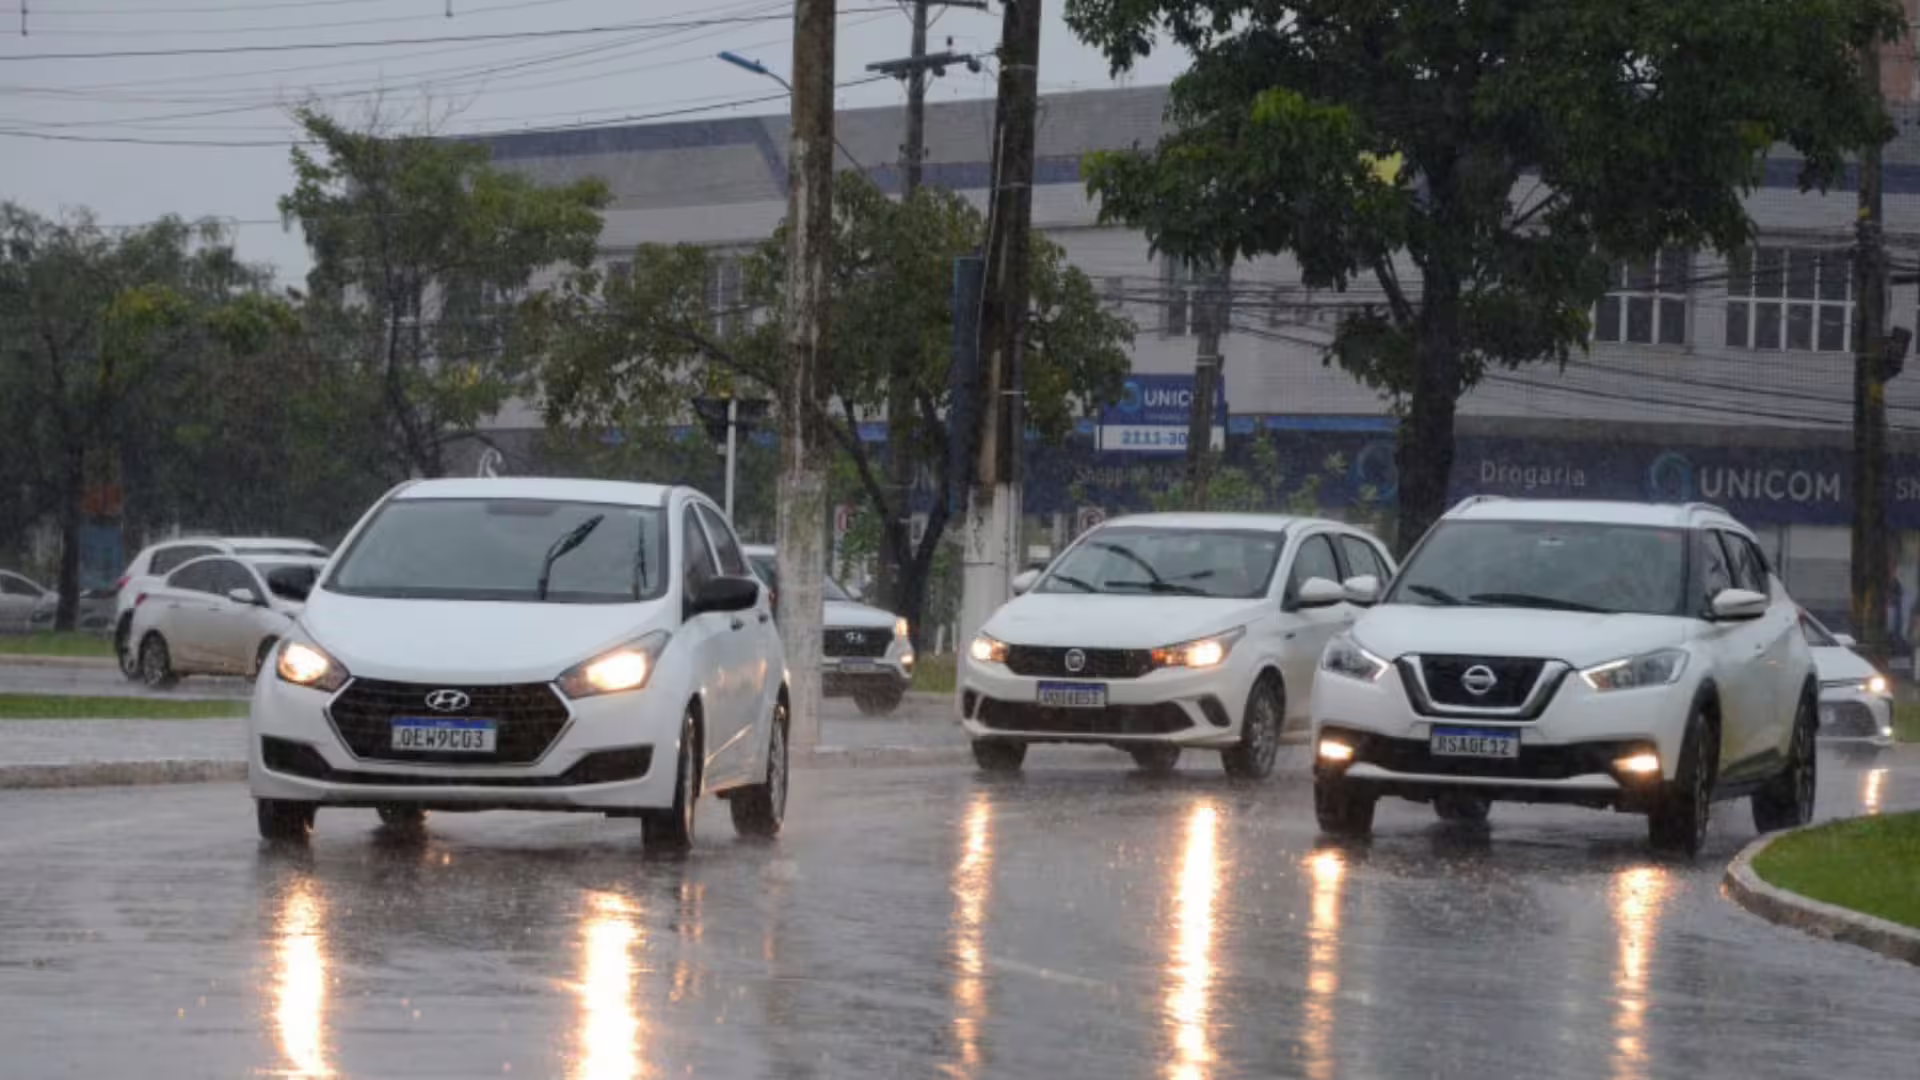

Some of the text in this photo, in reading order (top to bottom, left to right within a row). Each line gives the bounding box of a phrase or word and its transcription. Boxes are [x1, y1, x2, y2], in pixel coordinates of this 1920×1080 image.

[1144, 389, 1204, 407] UNIC
[1481, 460, 1585, 489] Drogaria
[1701, 467, 1840, 502] UNICOM
